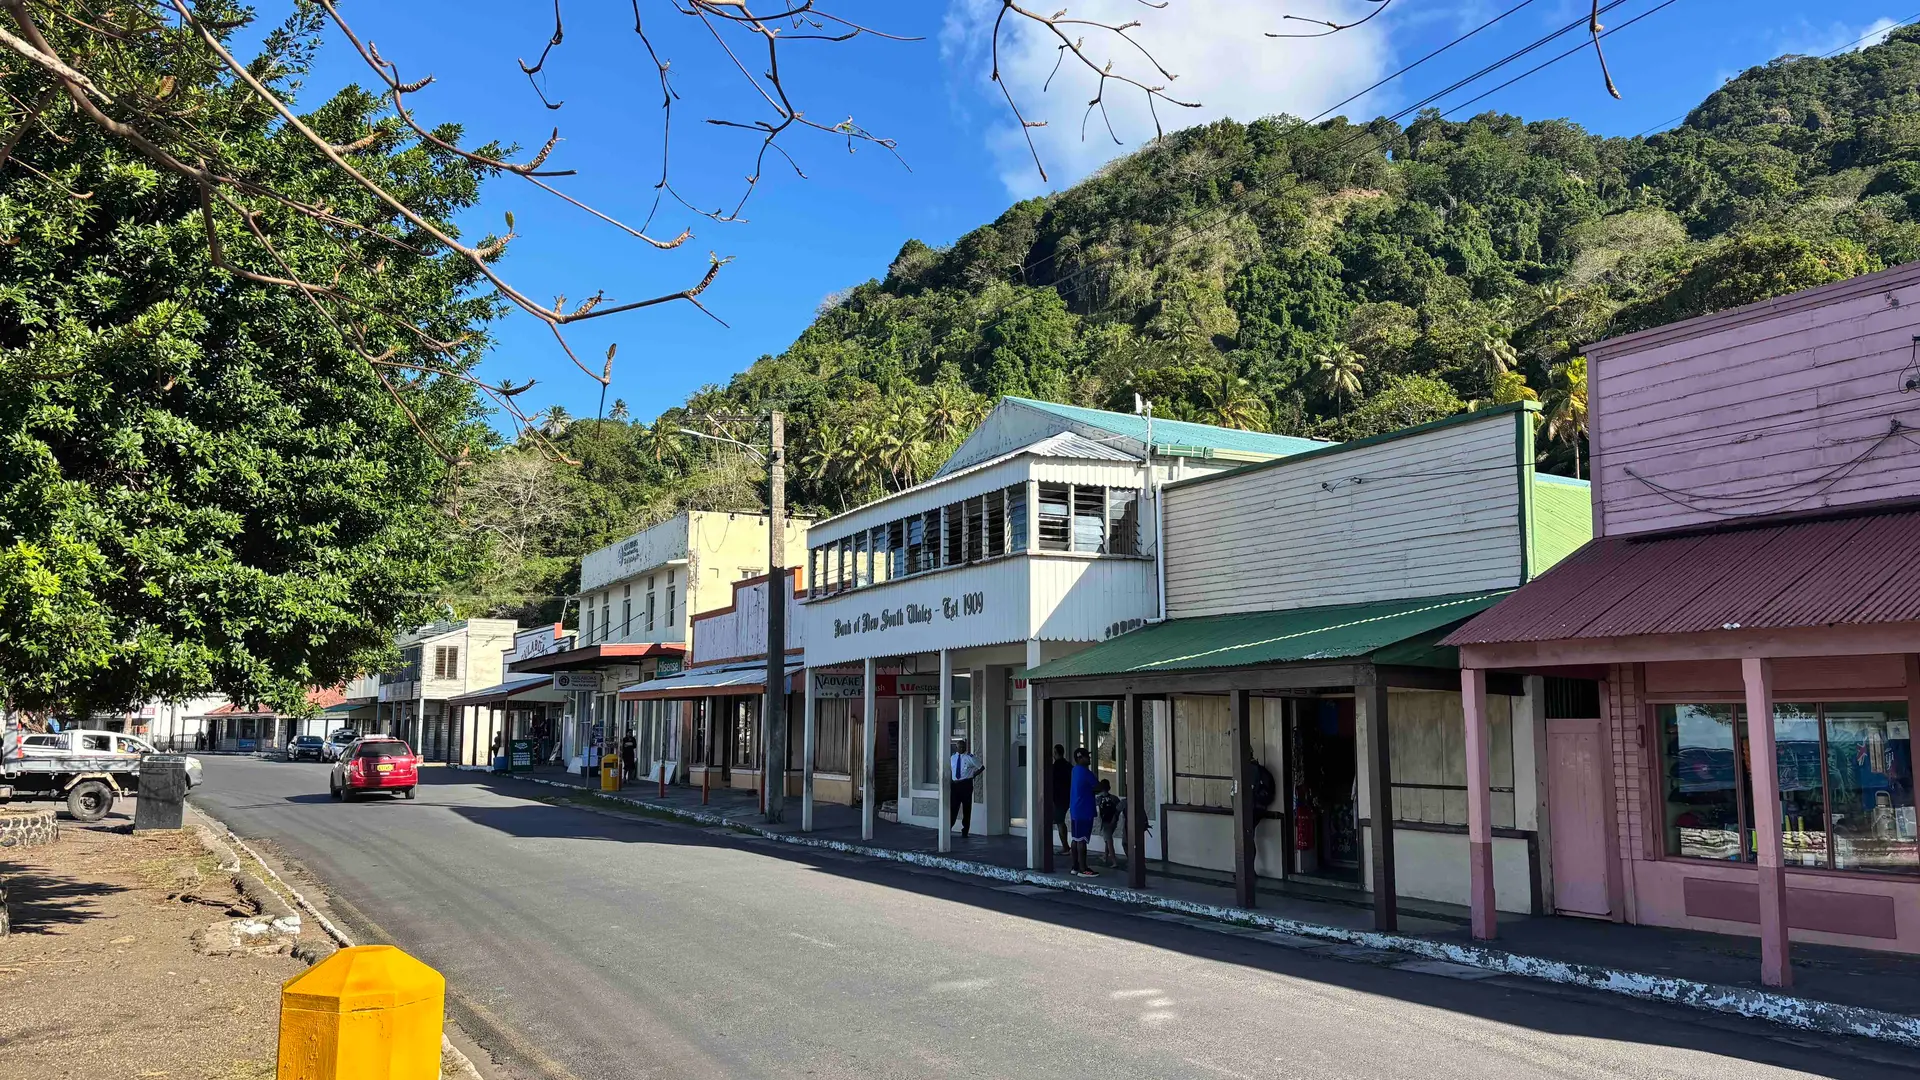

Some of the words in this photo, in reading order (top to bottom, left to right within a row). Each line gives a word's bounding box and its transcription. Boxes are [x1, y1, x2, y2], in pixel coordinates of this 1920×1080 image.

[834, 618, 851, 639] Bank
[853, 616, 861, 634] of
[861, 612, 879, 634] New
[880, 608, 904, 632] South
[906, 603, 932, 625] Wales
[963, 591, 984, 617] 1909
